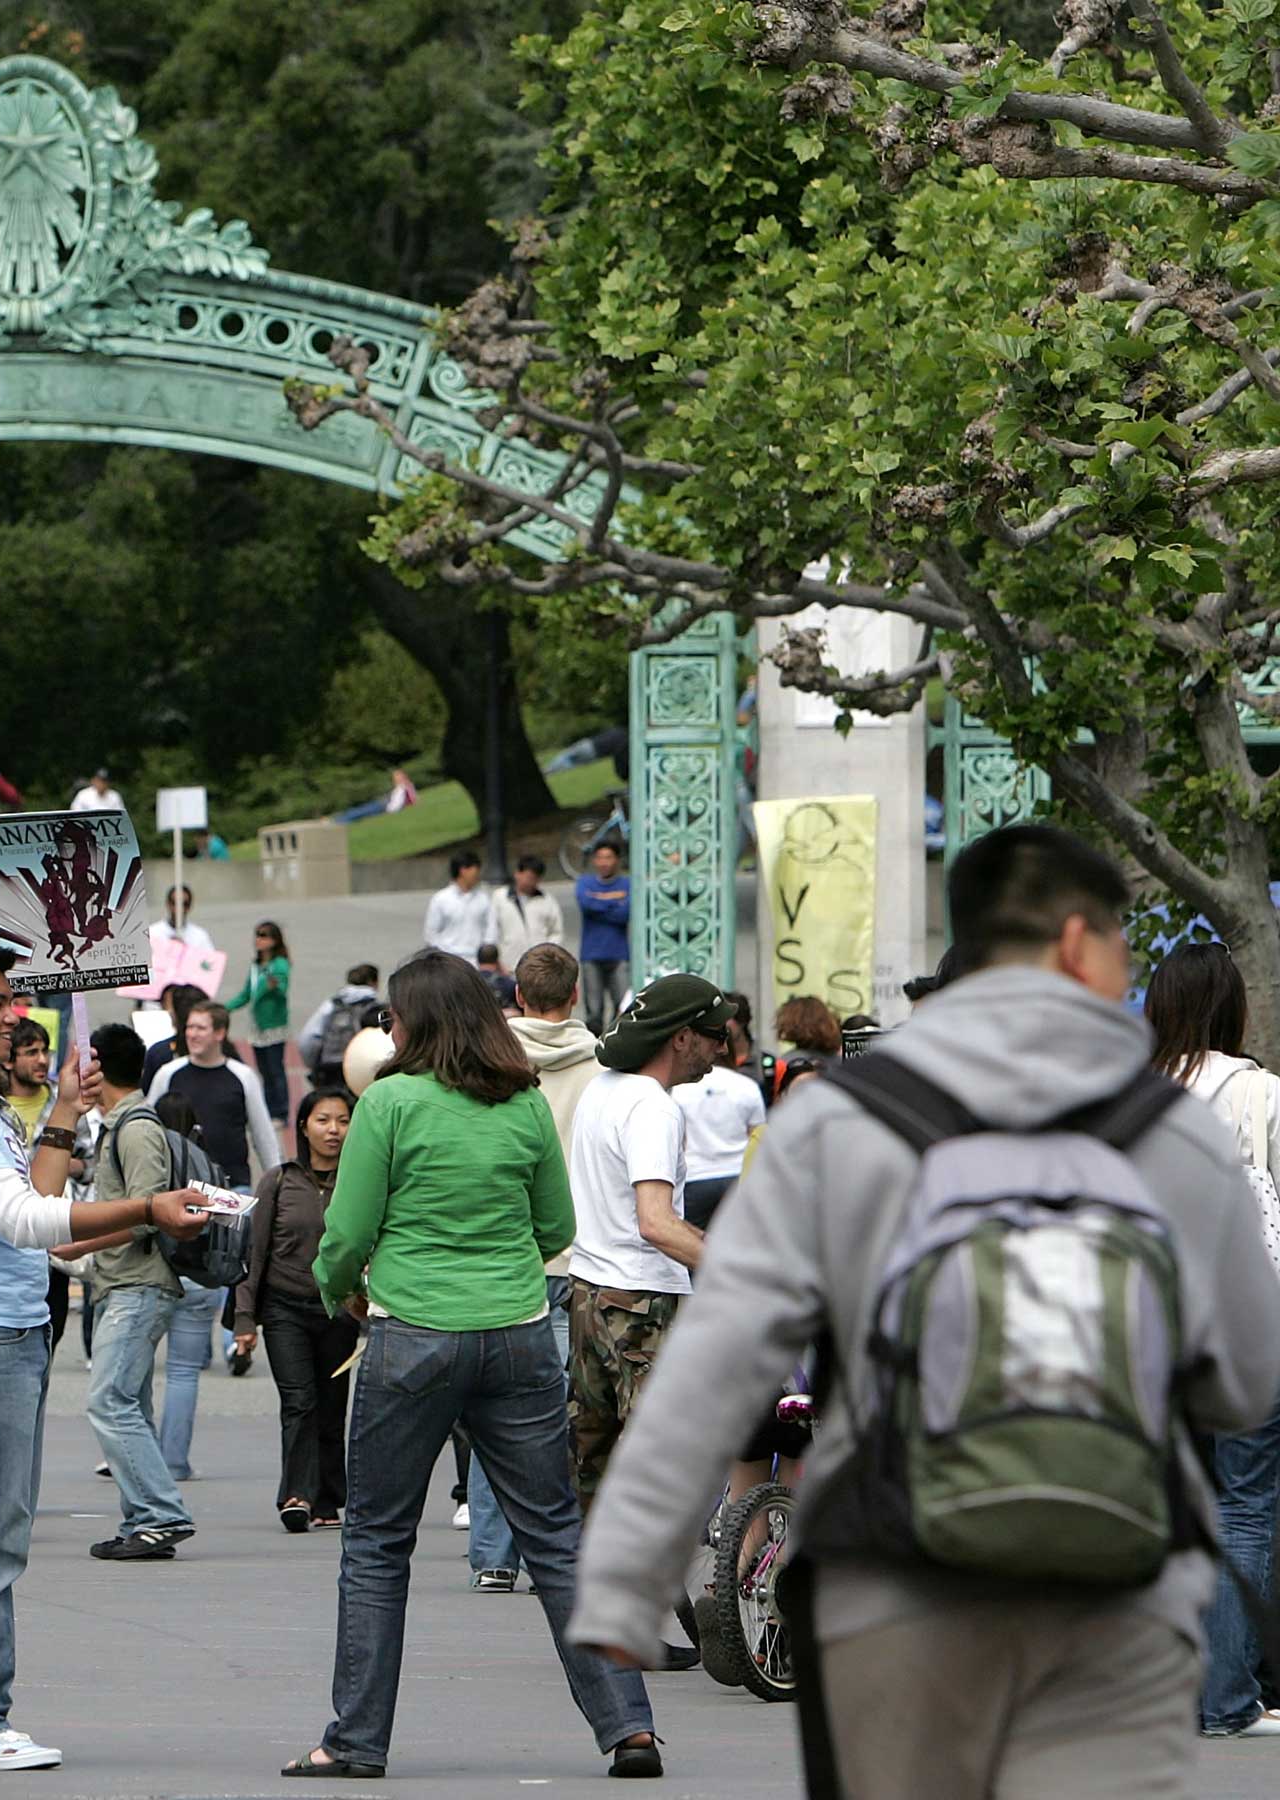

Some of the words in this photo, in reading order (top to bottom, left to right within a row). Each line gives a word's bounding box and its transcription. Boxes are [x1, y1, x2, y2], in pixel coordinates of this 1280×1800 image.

[92, 368, 259, 429] GATE
[110, 953, 138, 966] 2007
[24, 974, 59, 985] berkeley
